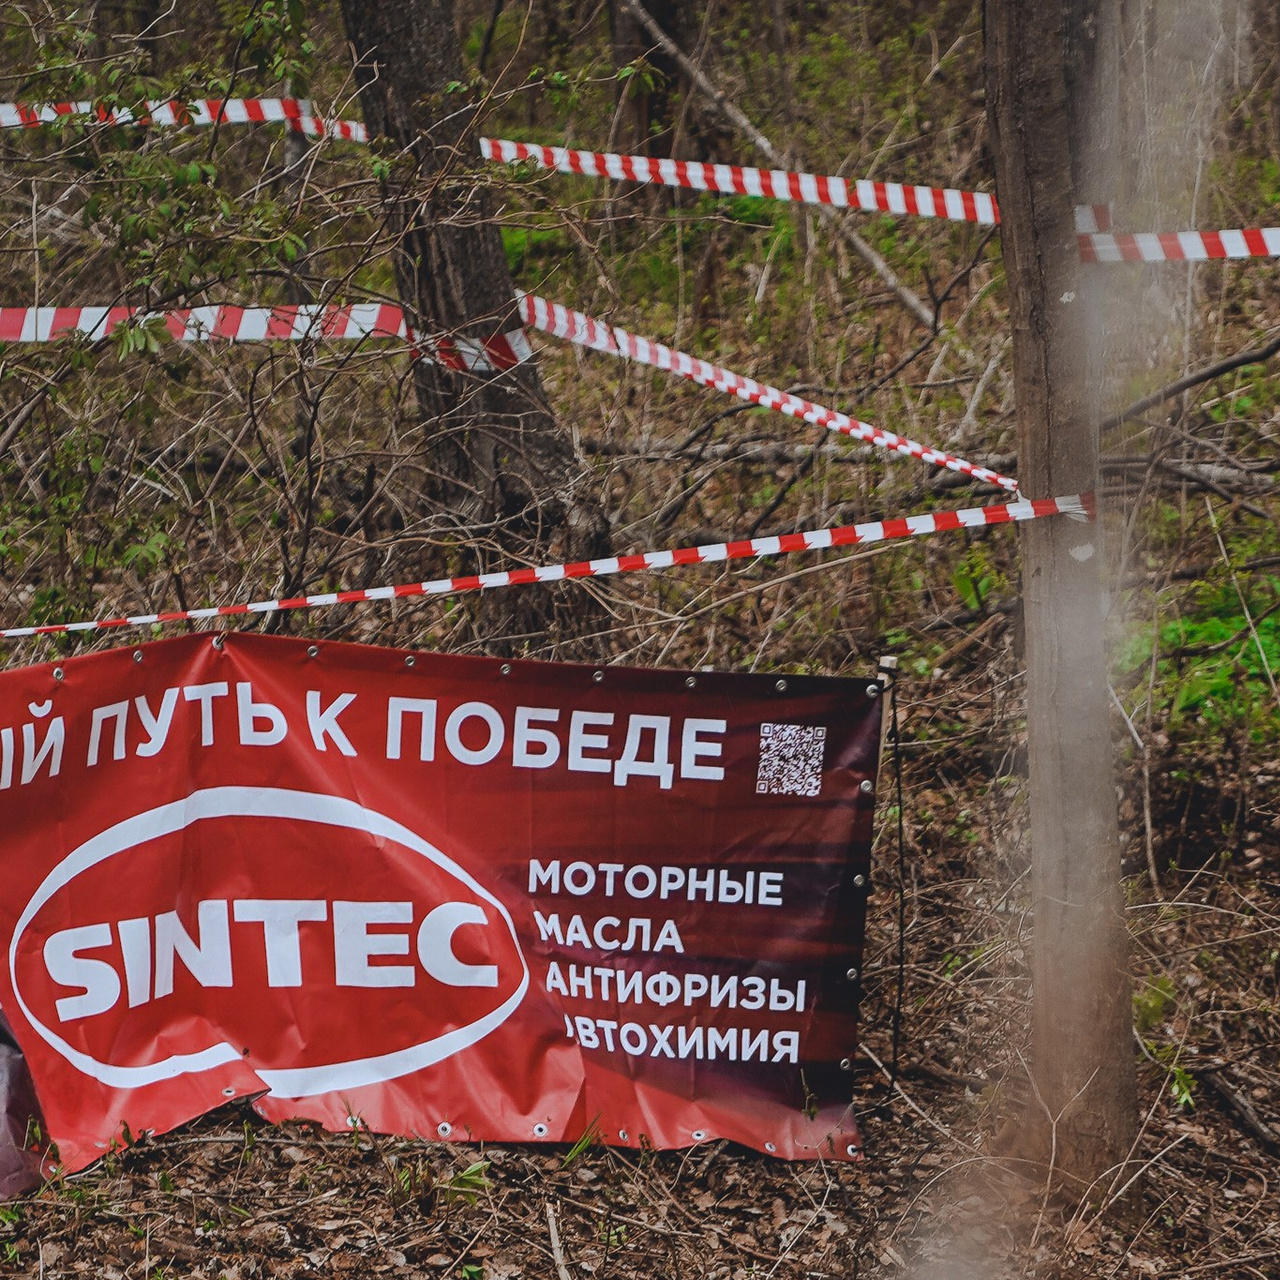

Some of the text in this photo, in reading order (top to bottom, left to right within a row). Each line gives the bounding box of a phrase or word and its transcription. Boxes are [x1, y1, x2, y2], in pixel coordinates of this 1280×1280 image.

[87, 681, 288, 767] ПУТЬ
[307, 690, 358, 757] К
[387, 697, 727, 790] ПОБЕДЕ
[528, 858, 784, 906] МОТОРНЫЕ
[533, 910, 685, 953] МАСЛА
[42, 898, 499, 1023] SINTEC
[546, 961, 806, 1013] АНТИФРИЗЫ
[564, 1013, 800, 1064] ВТОХИМИЯ
